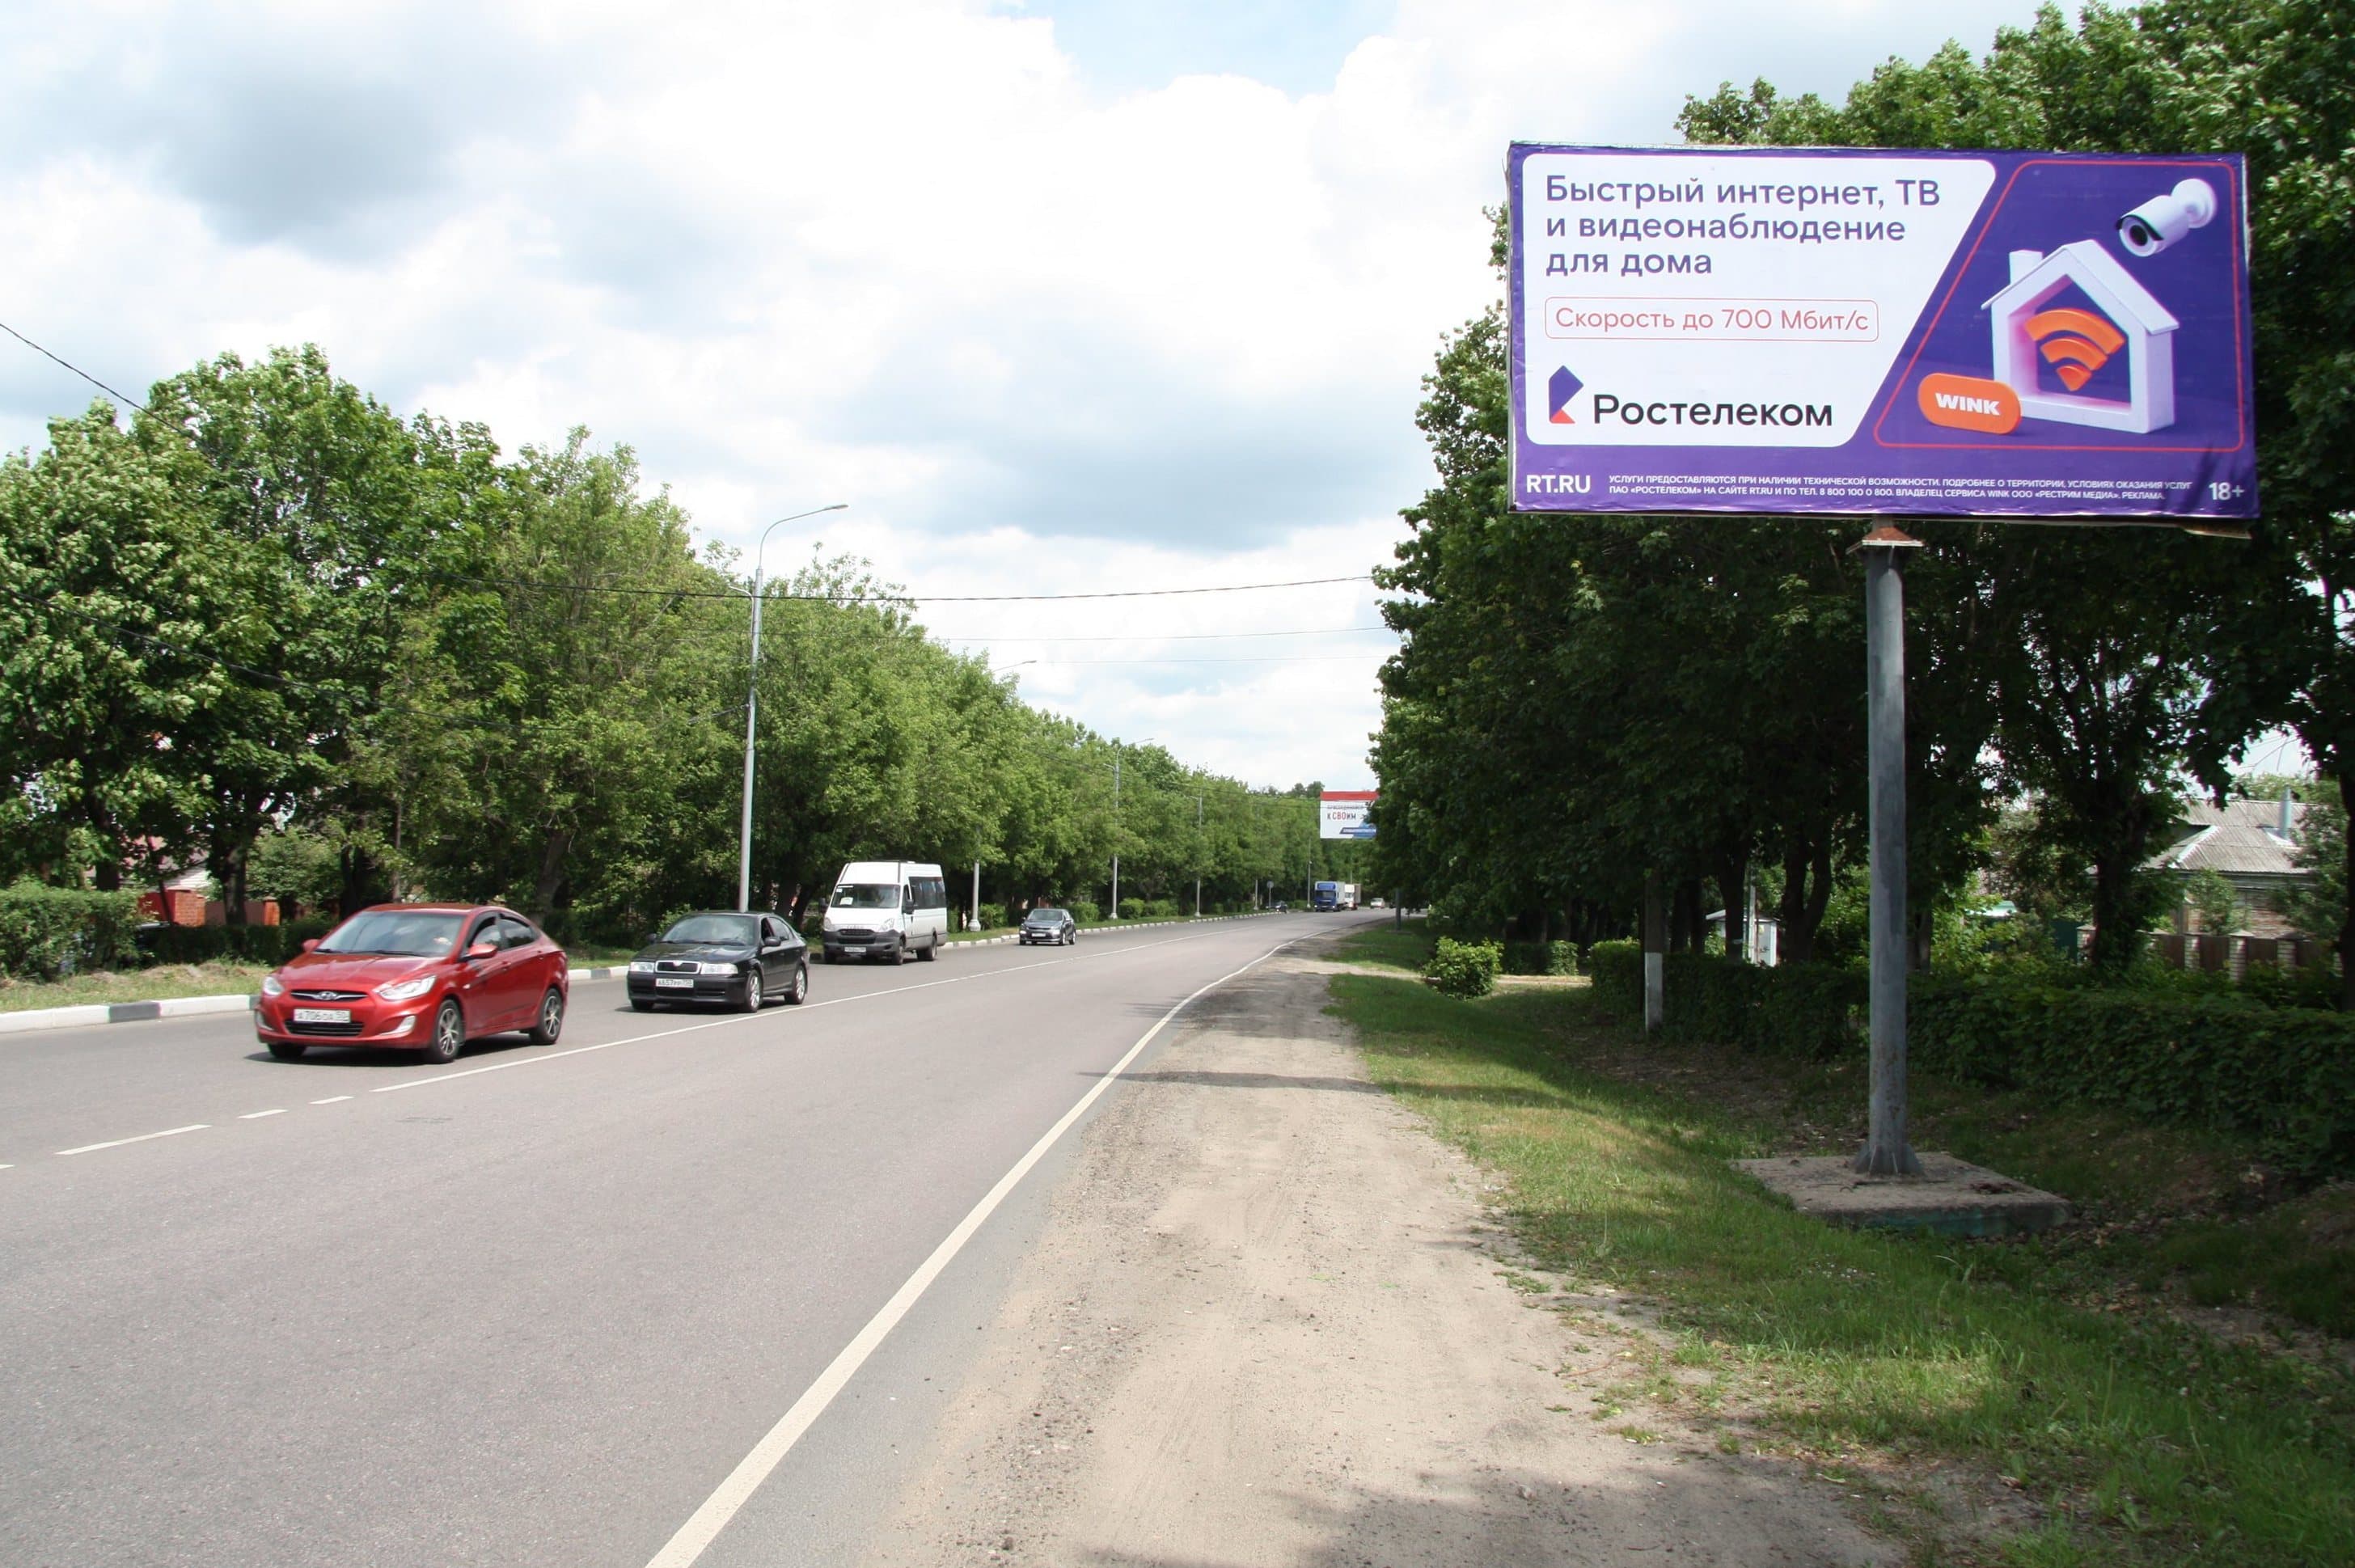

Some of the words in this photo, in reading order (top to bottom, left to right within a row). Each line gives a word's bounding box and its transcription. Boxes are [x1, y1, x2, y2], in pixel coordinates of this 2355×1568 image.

[1546, 175, 1705, 209] Быстрый
[1718, 184, 1885, 212] интернет,
[1896, 180, 1941, 205] ТВ
[1546, 218, 1566, 236] и
[1579, 213, 1906, 244] видеонаблюдение
[1545, 253, 1609, 277] для
[1621, 253, 1713, 277] дома
[1555, 307, 1676, 332] Скорость
[1683, 314, 1714, 332] до
[1722, 309, 1773, 329] 700
[1782, 310, 1869, 332] Мбит/с
[1594, 394, 1833, 427] Ростелеком
[1934, 391, 2001, 416] WINK
[1526, 475, 1592, 493] RT.RU
[1609, 475, 1644, 484] УСЛУГИ
[1646, 475, 1736, 484] ПРЕДОСТАВЛЯЮТСЯ
[1738, 476, 1757, 484] ПРИ
[1759, 476, 1801, 485] НАЛИЧИИ
[1803, 476, 1867, 486] ТЕХНИЧЕСКОЙ
[1868, 477, 1940, 487] ВОЗМОЖНОСТИ.
[1943, 478, 1996, 488] ПОДРОБНЕЕ
[1997, 479, 2005, 487] О
[2067, 480, 2115, 488] УСЛОВИЯХ
[2116, 480, 2163, 489] ОКАЗАНИЯ
[2164, 481, 2193, 489] УСЛУГ
[1609, 485, 1628, 494] ПАО
[1630, 486, 1702, 495] «РОСТЕЛЕКОМ»
[1704, 487, 1716, 495] НА
[1718, 485, 1748, 495] САЙТЕ
[1749, 487, 1773, 495] RT.RU
[1783, 488, 1797, 496] ПО
[1799, 488, 1818, 496] ТЕЛ.
[1820, 488, 1825, 496] 8
[1874, 488, 1895, 497] 800.
[1896, 489, 1943, 497] ВЛАДЕЛЕЦ
[1945, 489, 1986, 497] СЕРВИСА
[2011, 490, 2033, 498] ООО
[2209, 482, 2245, 501] 18+
